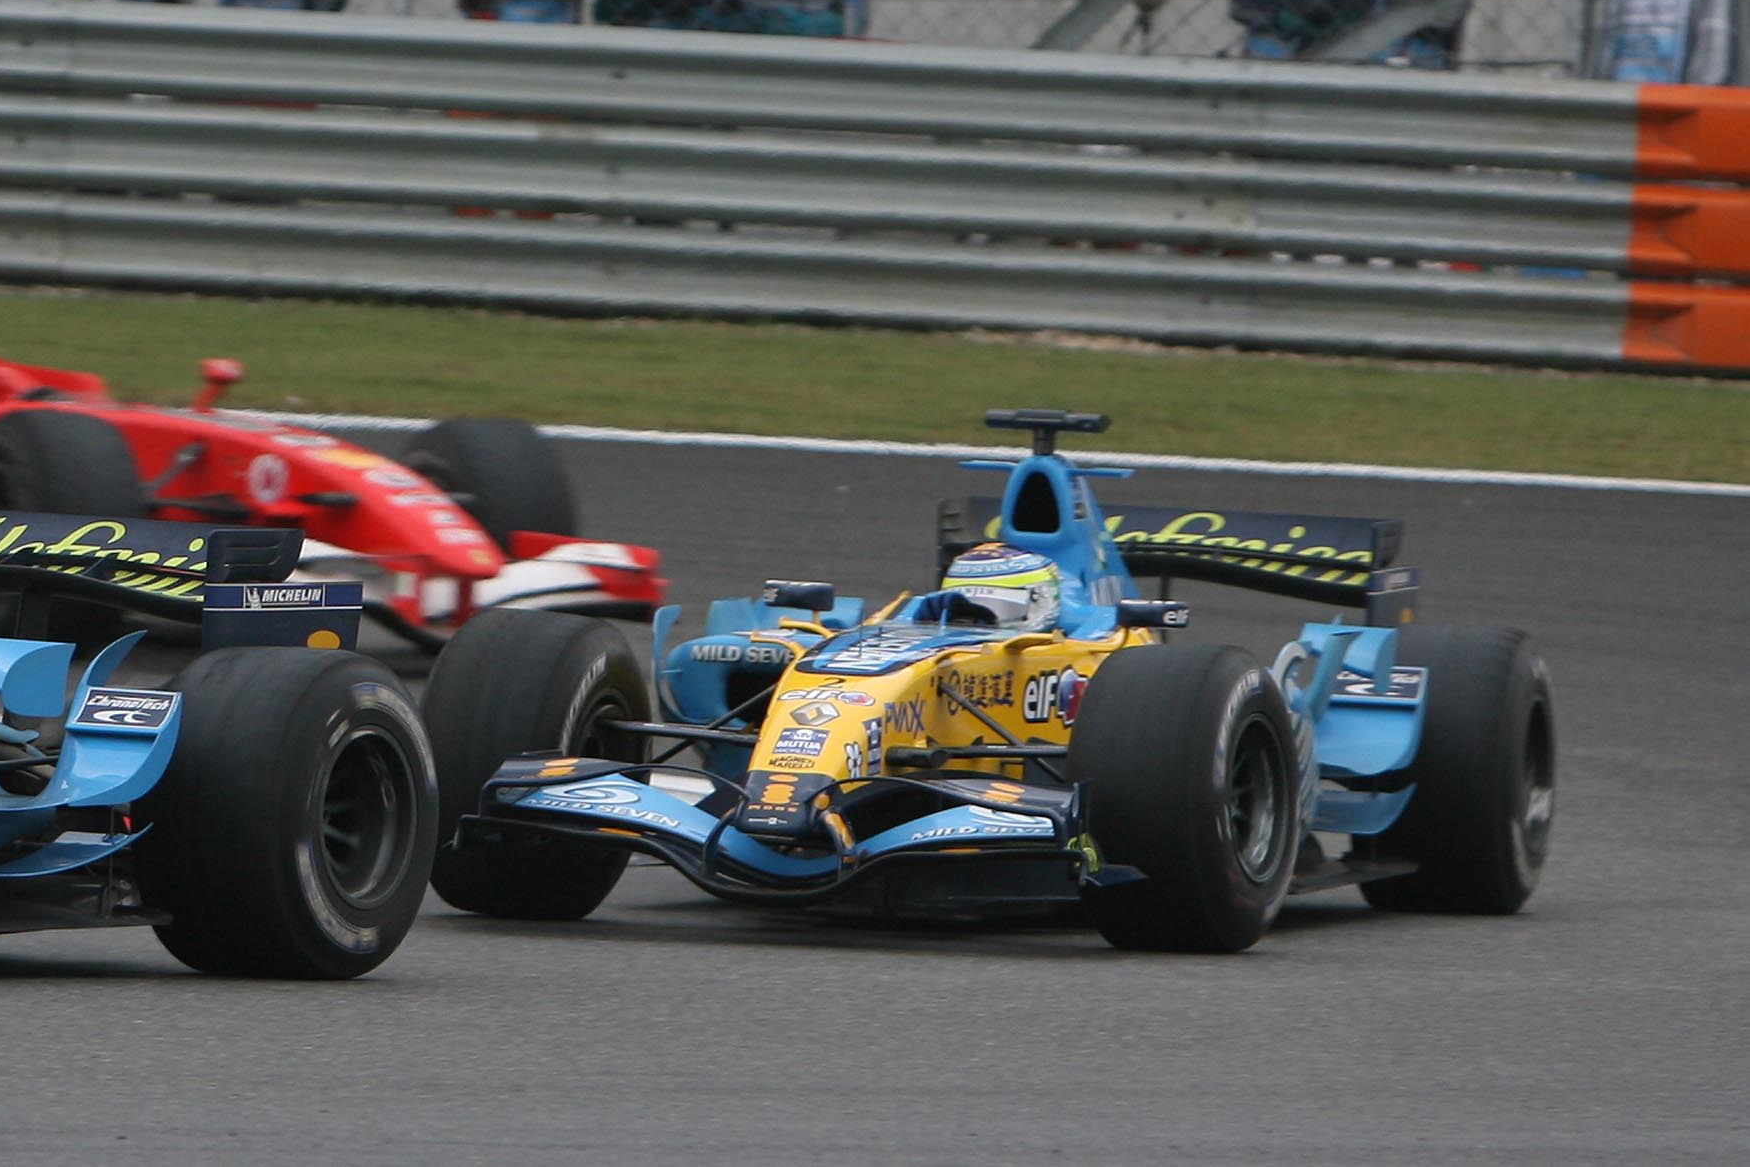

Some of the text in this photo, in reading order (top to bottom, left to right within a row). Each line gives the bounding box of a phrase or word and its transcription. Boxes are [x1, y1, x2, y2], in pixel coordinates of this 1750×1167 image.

[261, 588, 322, 602] MICHELIN
[1163, 608, 1190, 625] elf
[690, 645, 741, 661] MILD
[819, 677, 846, 689] 2
[778, 688, 843, 701] elf
[1024, 670, 1059, 722] elf
[776, 740, 821, 750] MUTUA
[527, 798, 681, 828] MILD SEVEN
[911, 825, 979, 841] MILD
